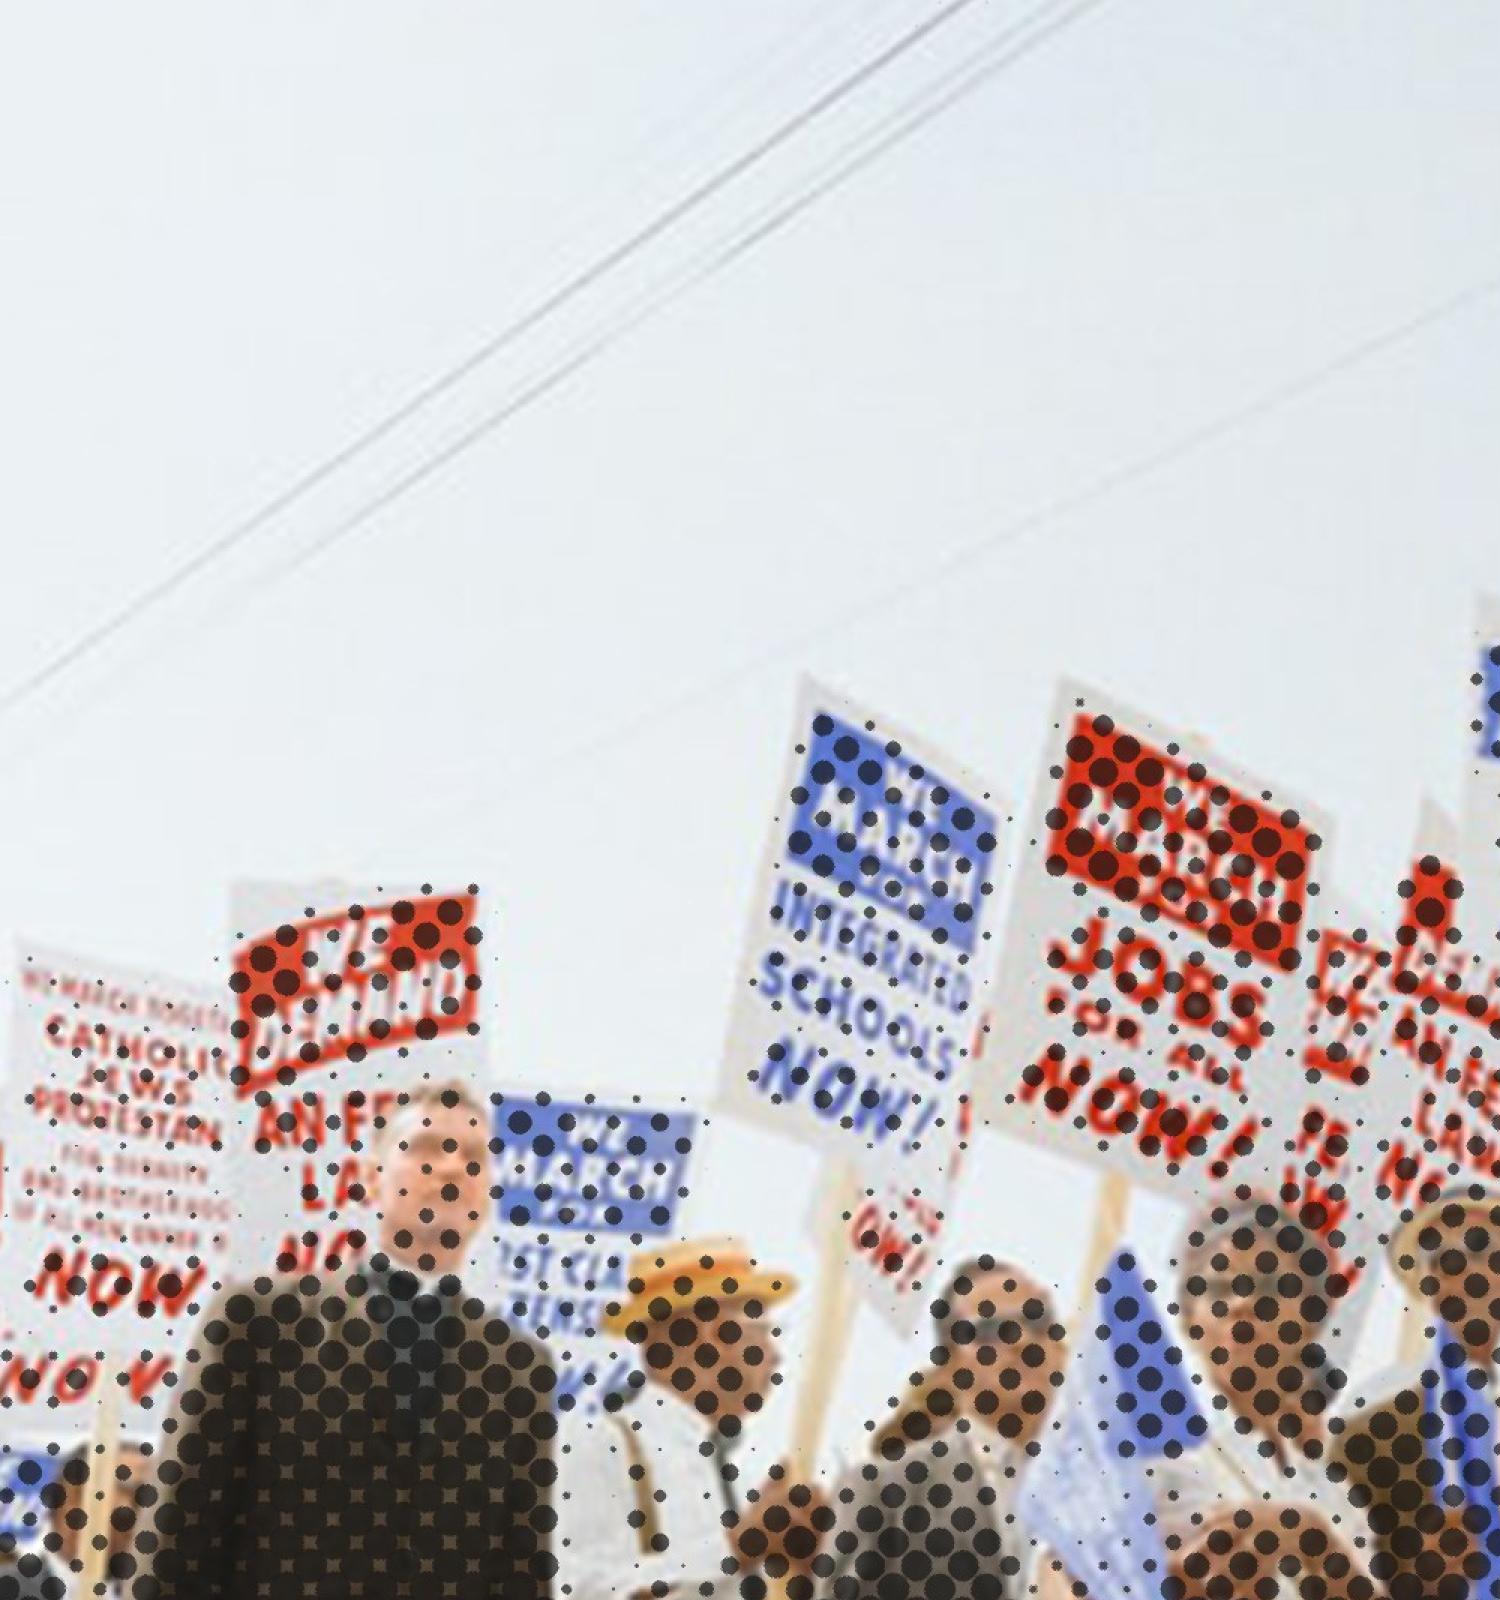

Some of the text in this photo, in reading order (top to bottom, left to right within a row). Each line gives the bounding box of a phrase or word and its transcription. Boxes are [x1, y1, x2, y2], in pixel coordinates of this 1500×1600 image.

[814, 778, 978, 914] MARCH
[1074, 792, 1290, 922] MARCH
[302, 912, 390, 982] WE
[772, 878, 973, 1015] INTEGRATED
[1047, 916, 1268, 1052] JOBS
[252, 956, 464, 1076] DEMAND
[759, 948, 958, 1082] SCHOOLS
[1168, 1040, 1246, 1095] ALL
[78, 1062, 193, 1106] JEWS
[257, 1096, 326, 1150] AN
[564, 1113, 630, 1149] WE
[757, 1035, 940, 1152] NOW!
[1018, 1050, 1260, 1180] NOW!
[498, 1146, 675, 1202] MARCH
